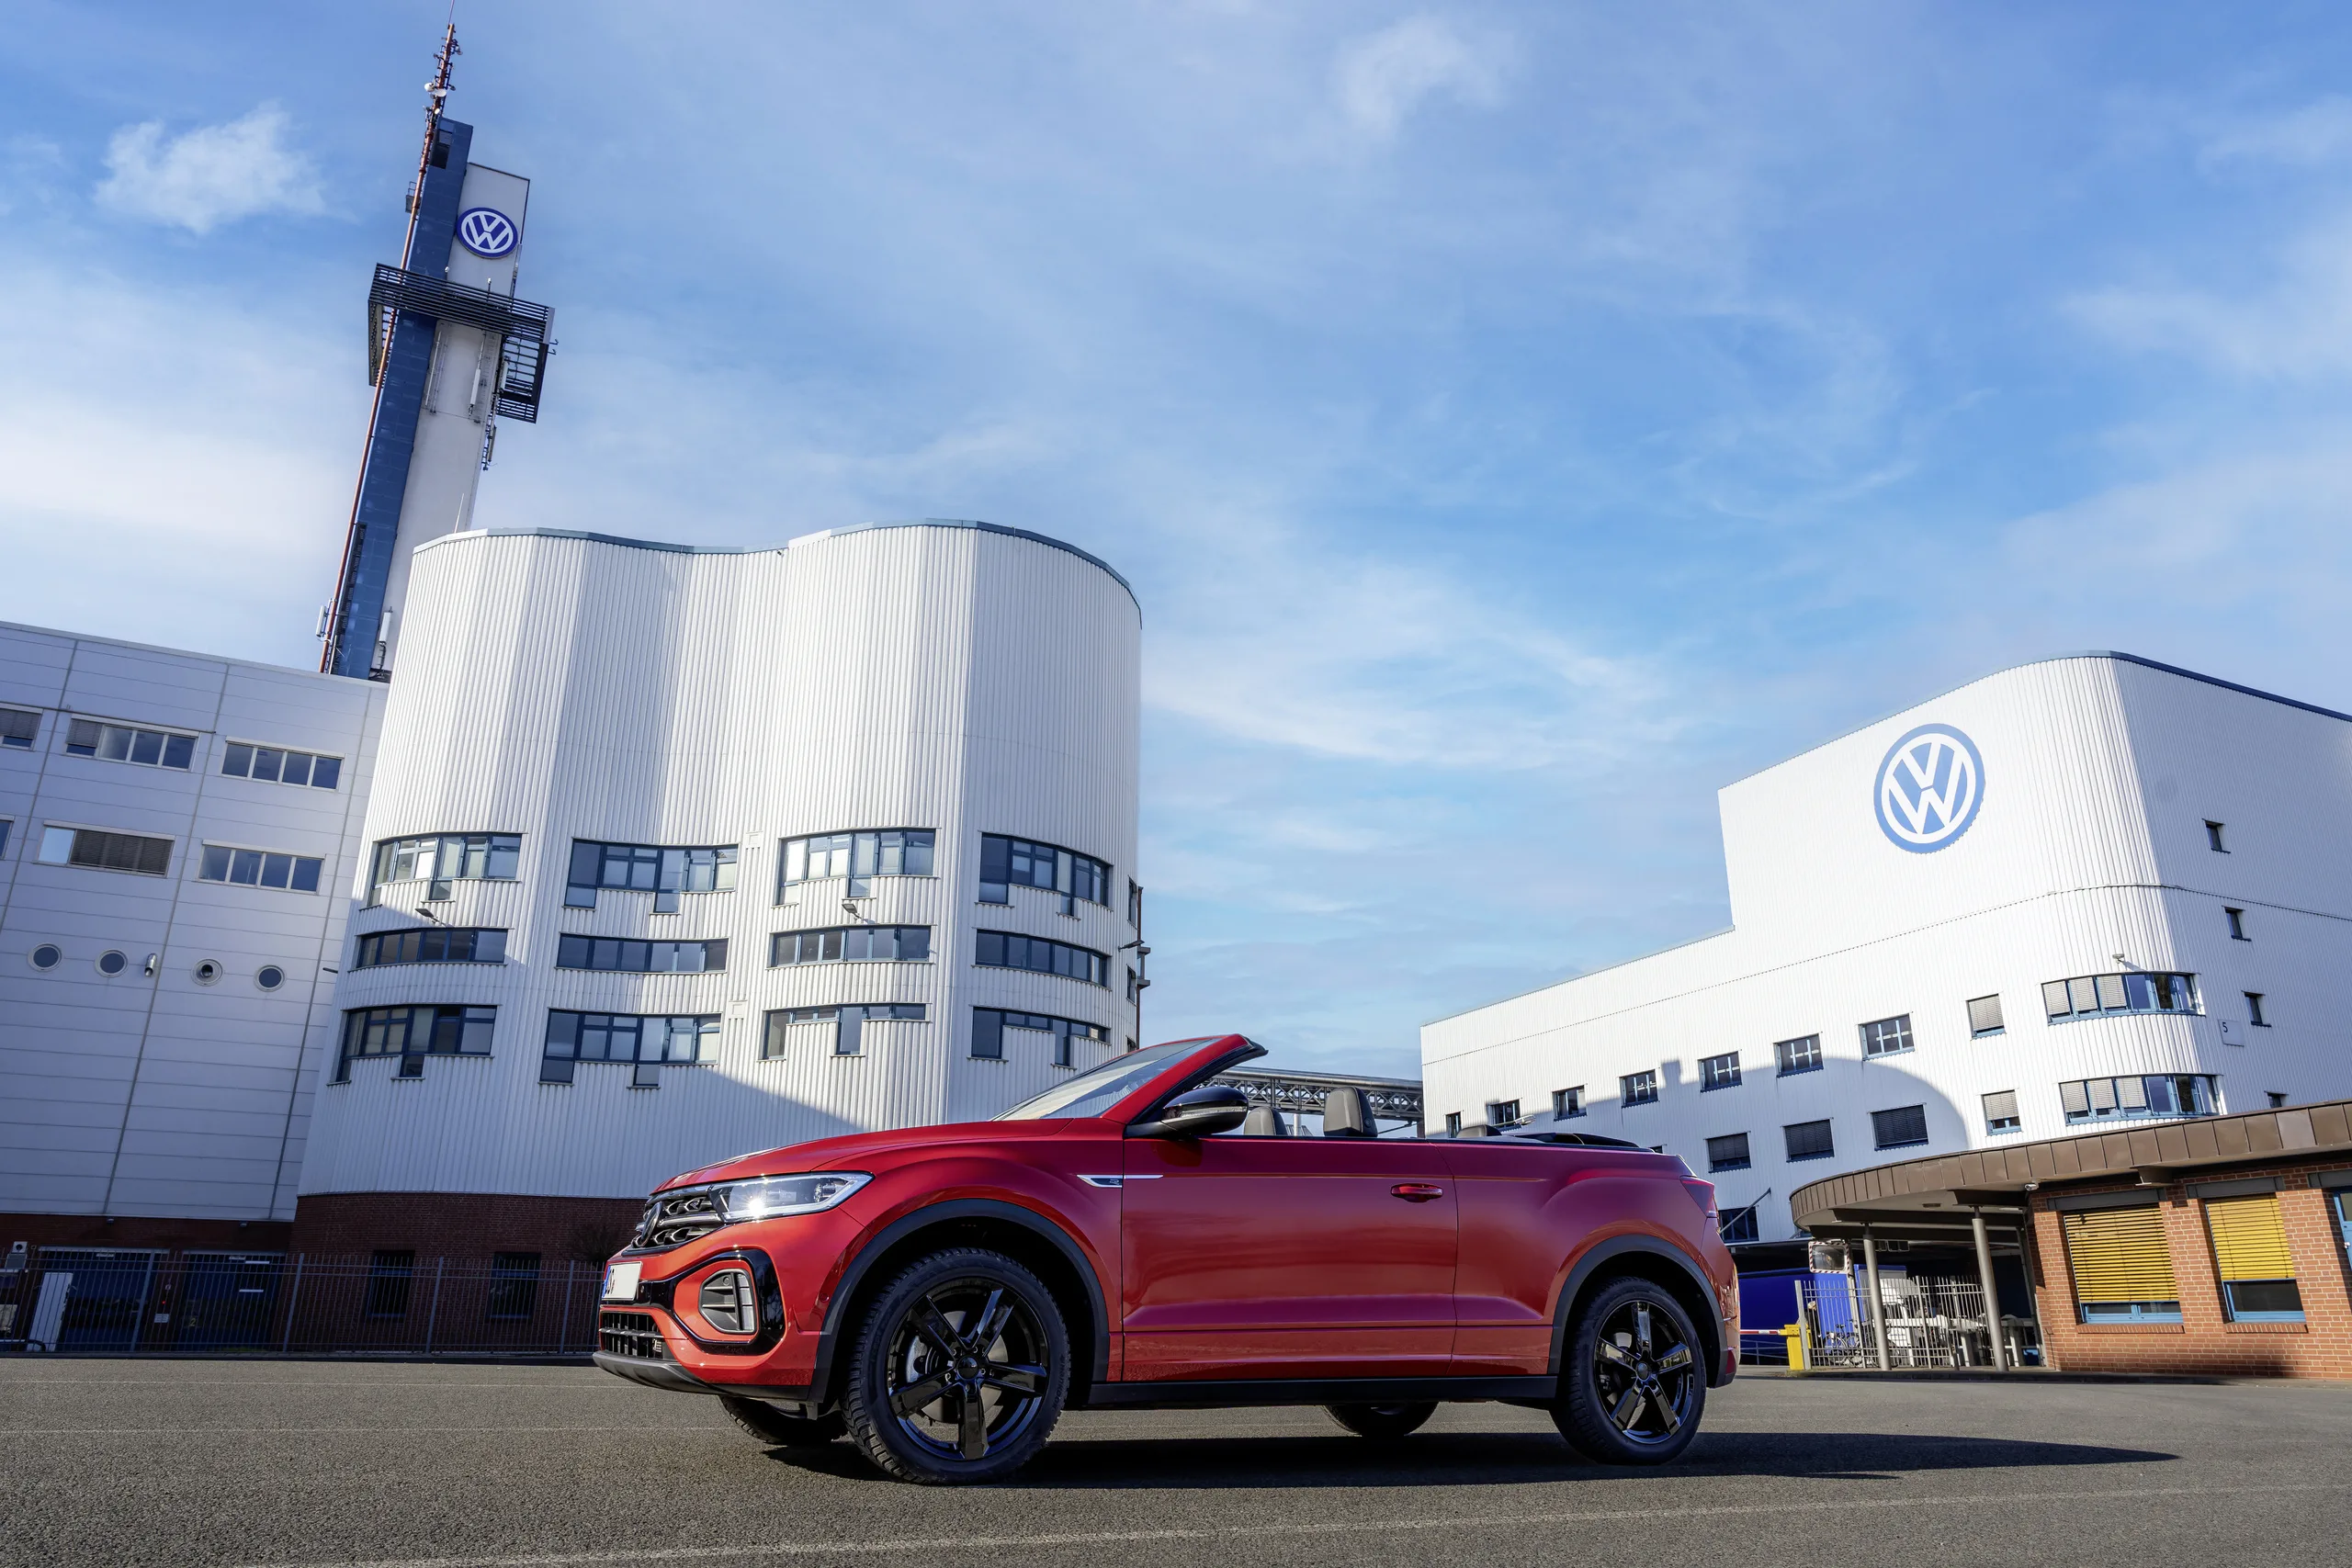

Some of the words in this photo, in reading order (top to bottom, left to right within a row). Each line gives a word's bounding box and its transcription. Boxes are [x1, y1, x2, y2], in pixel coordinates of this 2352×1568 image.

[461, 210, 514, 254] VW
[1882, 732, 1977, 844] VW
[2222, 1021, 2228, 1032] 5
